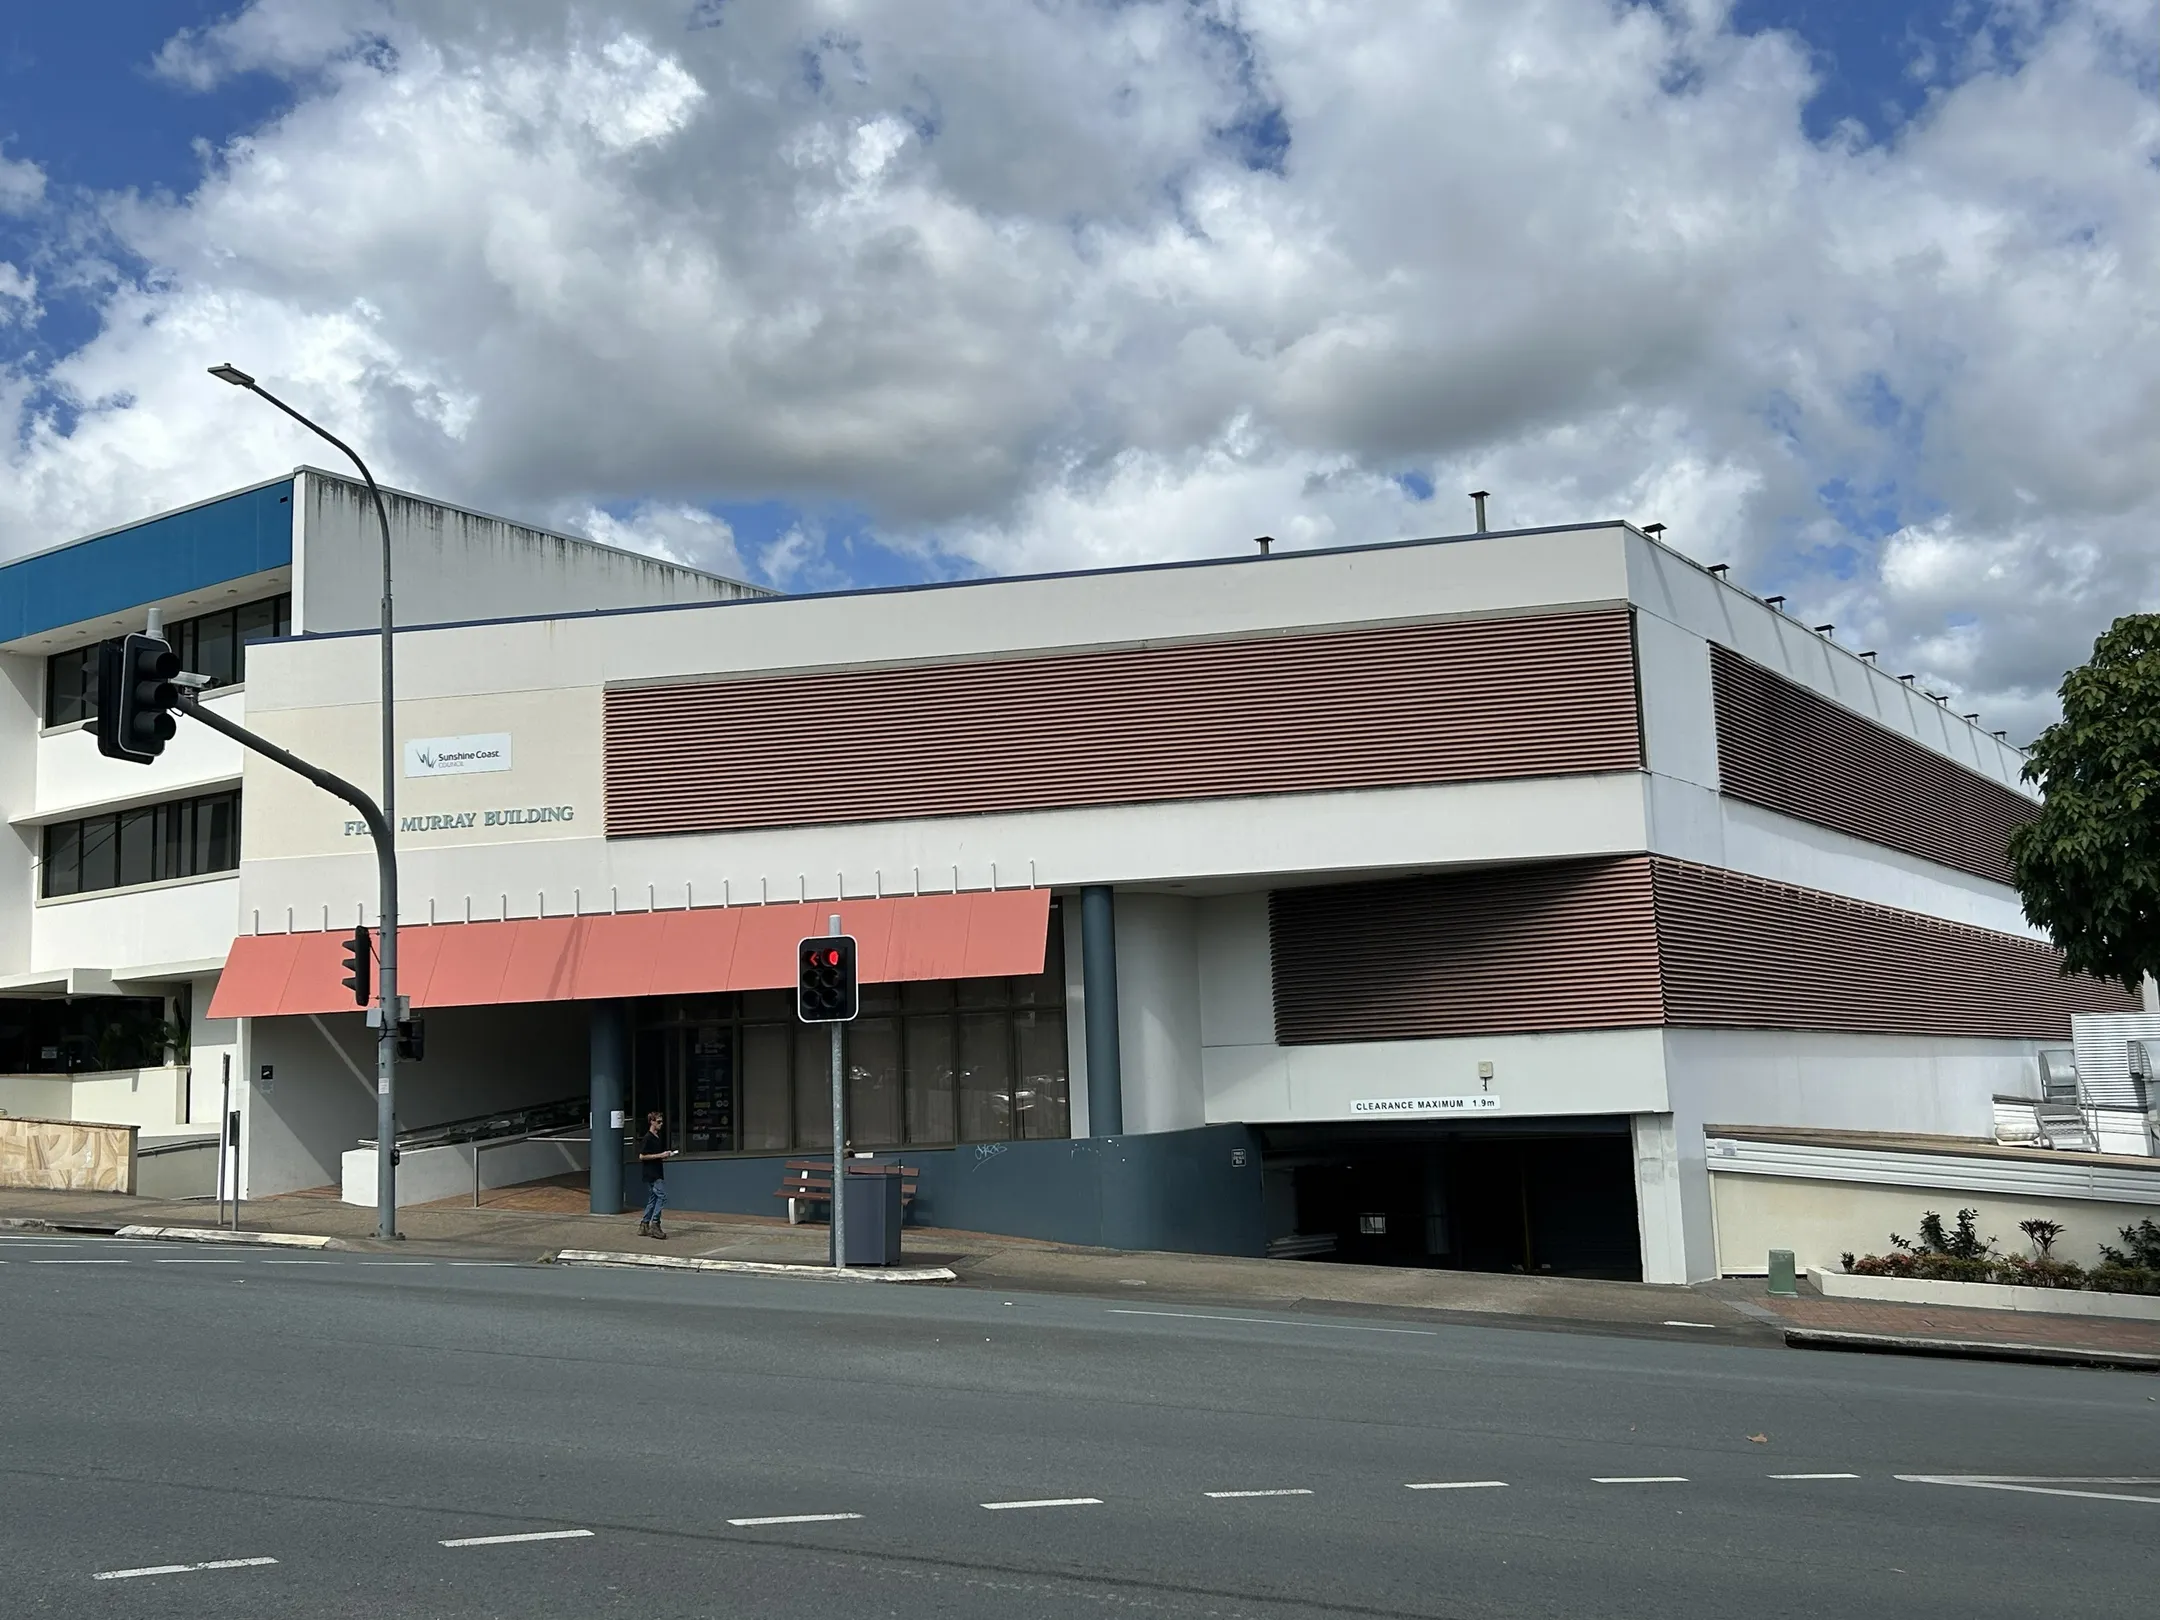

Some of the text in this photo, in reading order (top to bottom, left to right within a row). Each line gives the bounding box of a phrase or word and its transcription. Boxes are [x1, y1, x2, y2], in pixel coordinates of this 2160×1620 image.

[438, 750, 500, 761] Sunshine Coast
[401, 812, 476, 832] MURRAY
[484, 805, 574, 827] BUILDING
[1356, 1098, 1495, 1110] CLEARANCE MAXIMUM 1.9m
